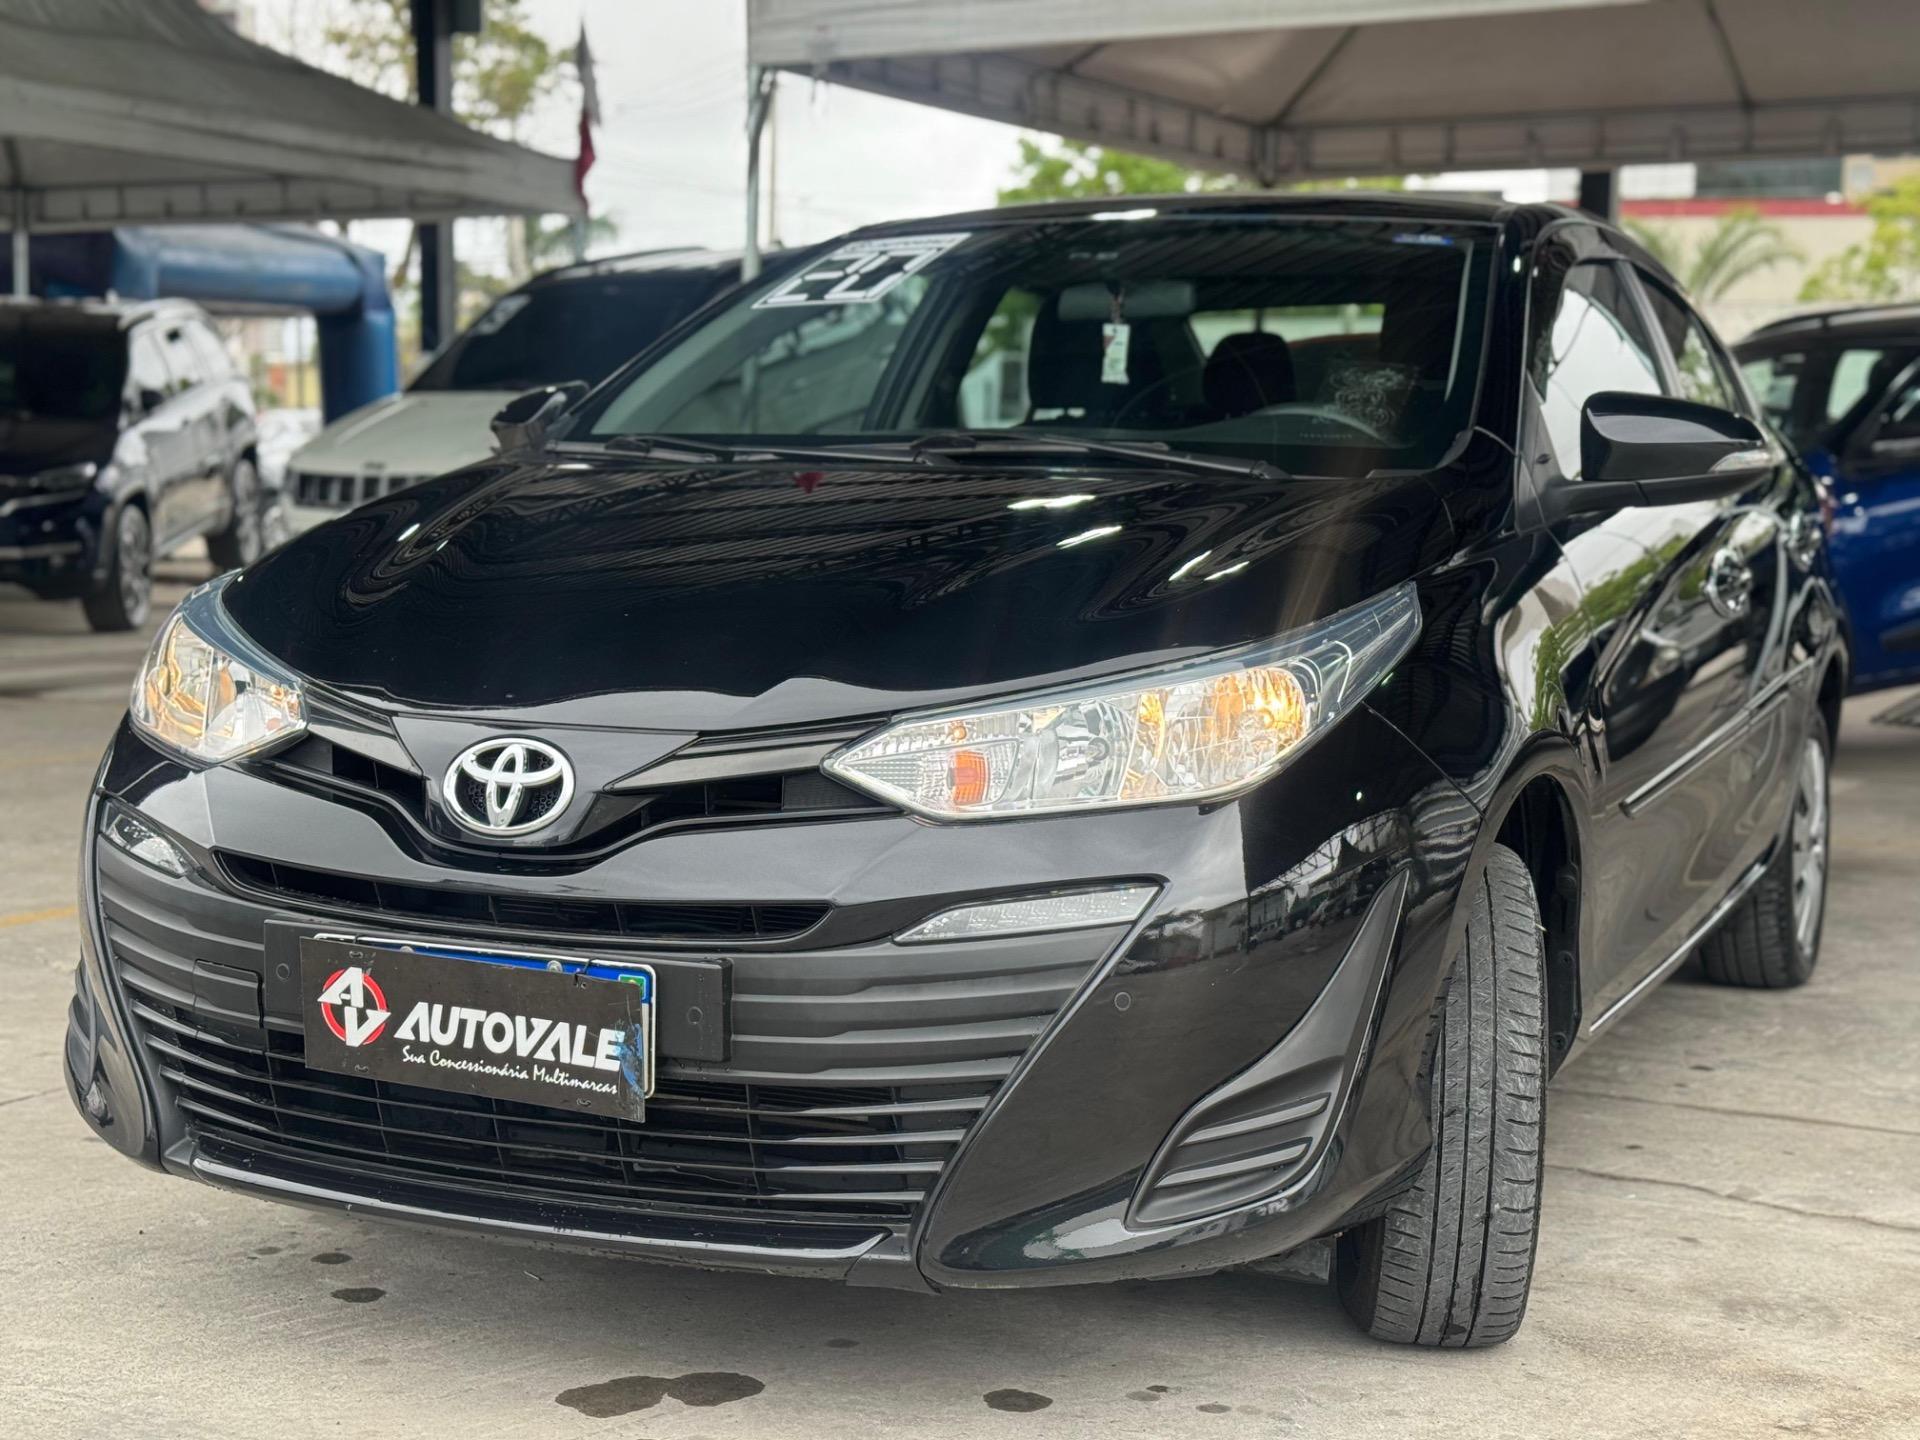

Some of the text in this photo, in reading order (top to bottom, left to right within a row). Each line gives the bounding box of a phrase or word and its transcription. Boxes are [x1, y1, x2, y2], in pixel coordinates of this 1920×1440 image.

[393, 1001, 625, 1072] AUTOVALE
[402, 1045, 618, 1095] Sua Concessionária Multimarcas
